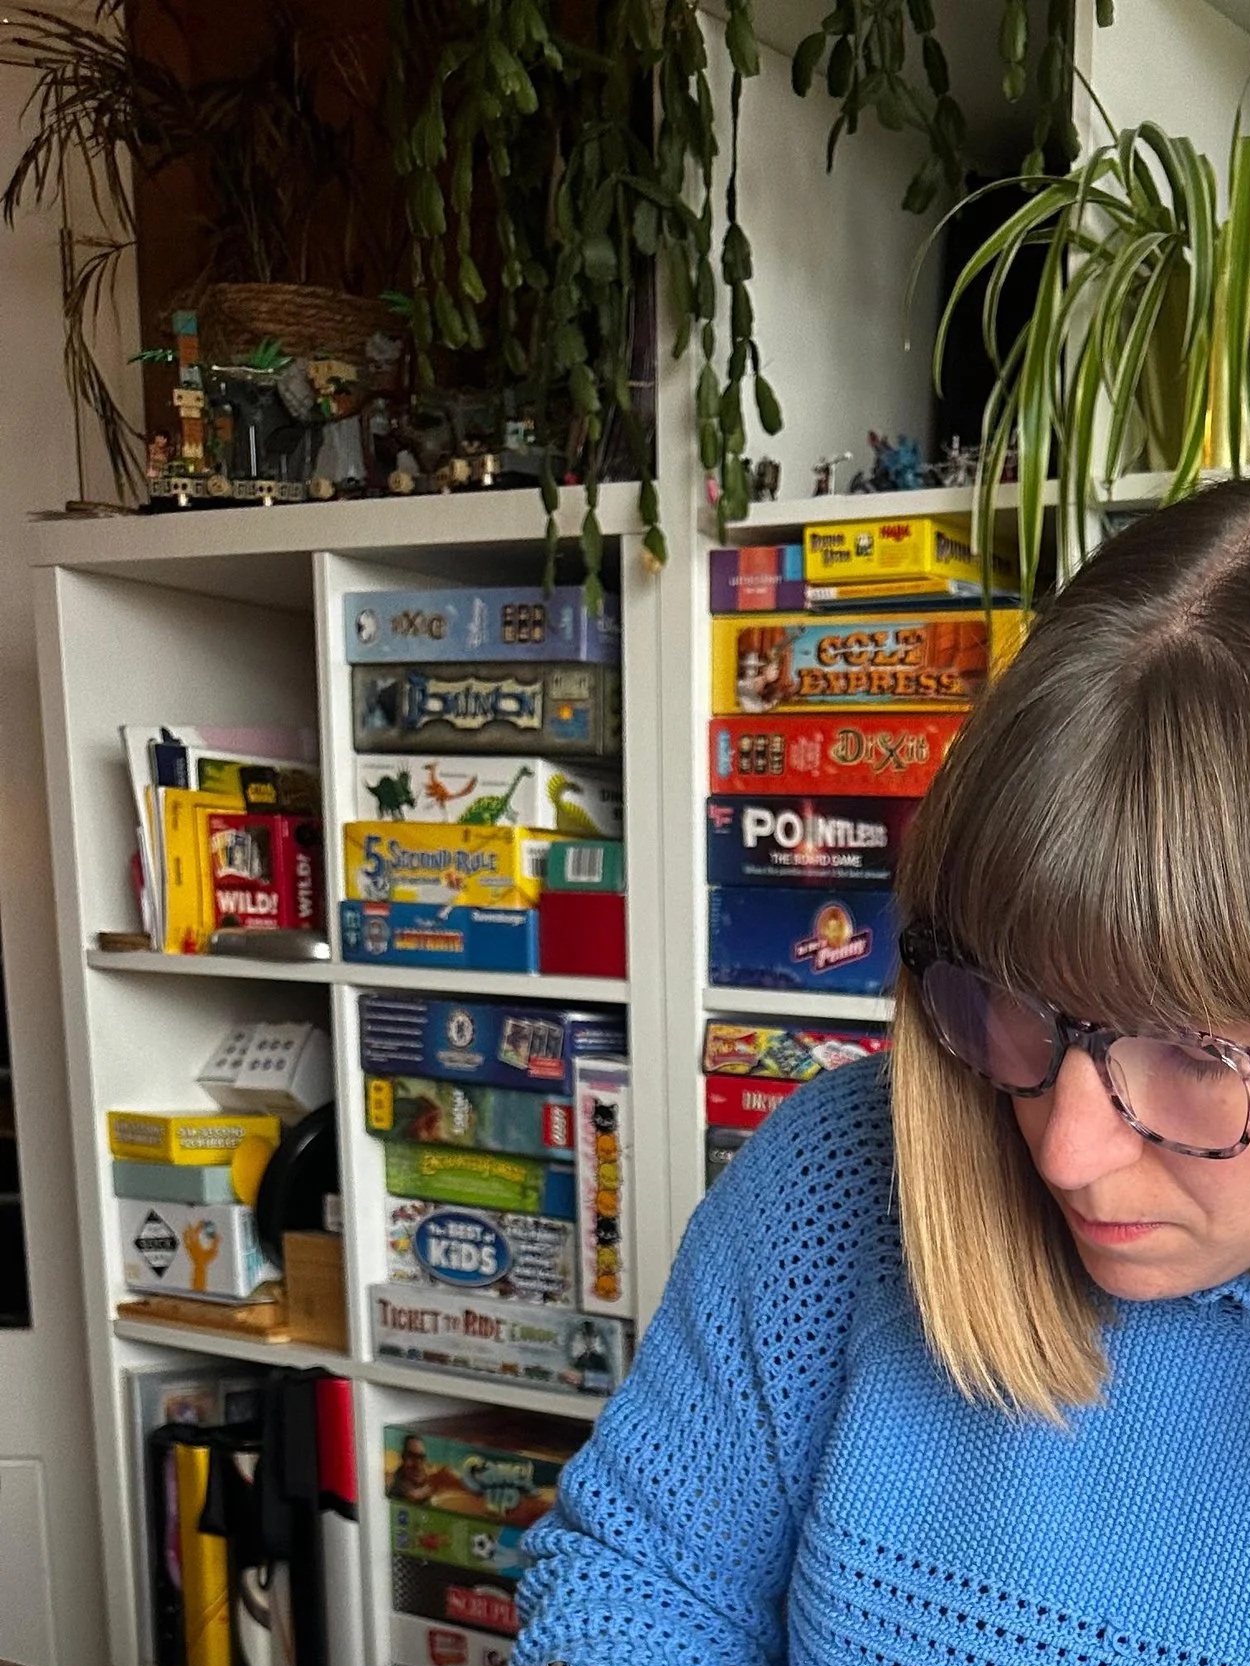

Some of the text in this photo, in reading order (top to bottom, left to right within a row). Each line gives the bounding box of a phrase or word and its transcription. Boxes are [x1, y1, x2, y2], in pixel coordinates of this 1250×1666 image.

[817, 628, 924, 667] COLT
[799, 668, 965, 697] EXPRESS
[741, 805, 888, 848] POINTLESS
[364, 836, 383, 877] 5
[457, 850, 498, 872] RULE
[770, 853, 792, 865] THE
[217, 889, 279, 915] WILD!
[297, 854, 312, 918] WILD!
[449, 1222, 482, 1241] BEST
[378, 1299, 441, 1334] TICKET
[463, 1308, 507, 1342] RIDE
